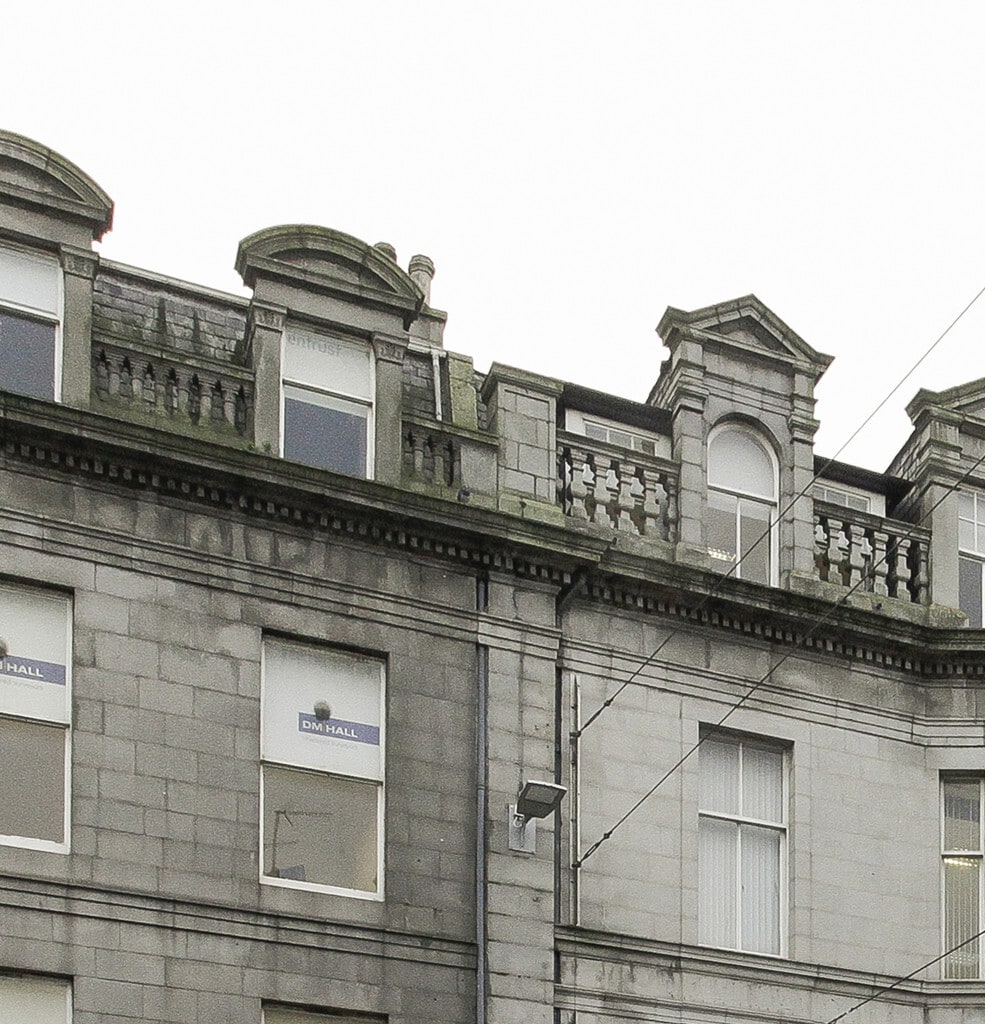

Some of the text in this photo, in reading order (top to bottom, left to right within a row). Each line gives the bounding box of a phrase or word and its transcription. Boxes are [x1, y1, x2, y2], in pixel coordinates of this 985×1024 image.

[7, 662, 44, 678] HALL
[302, 720, 358, 738] DM HALL
